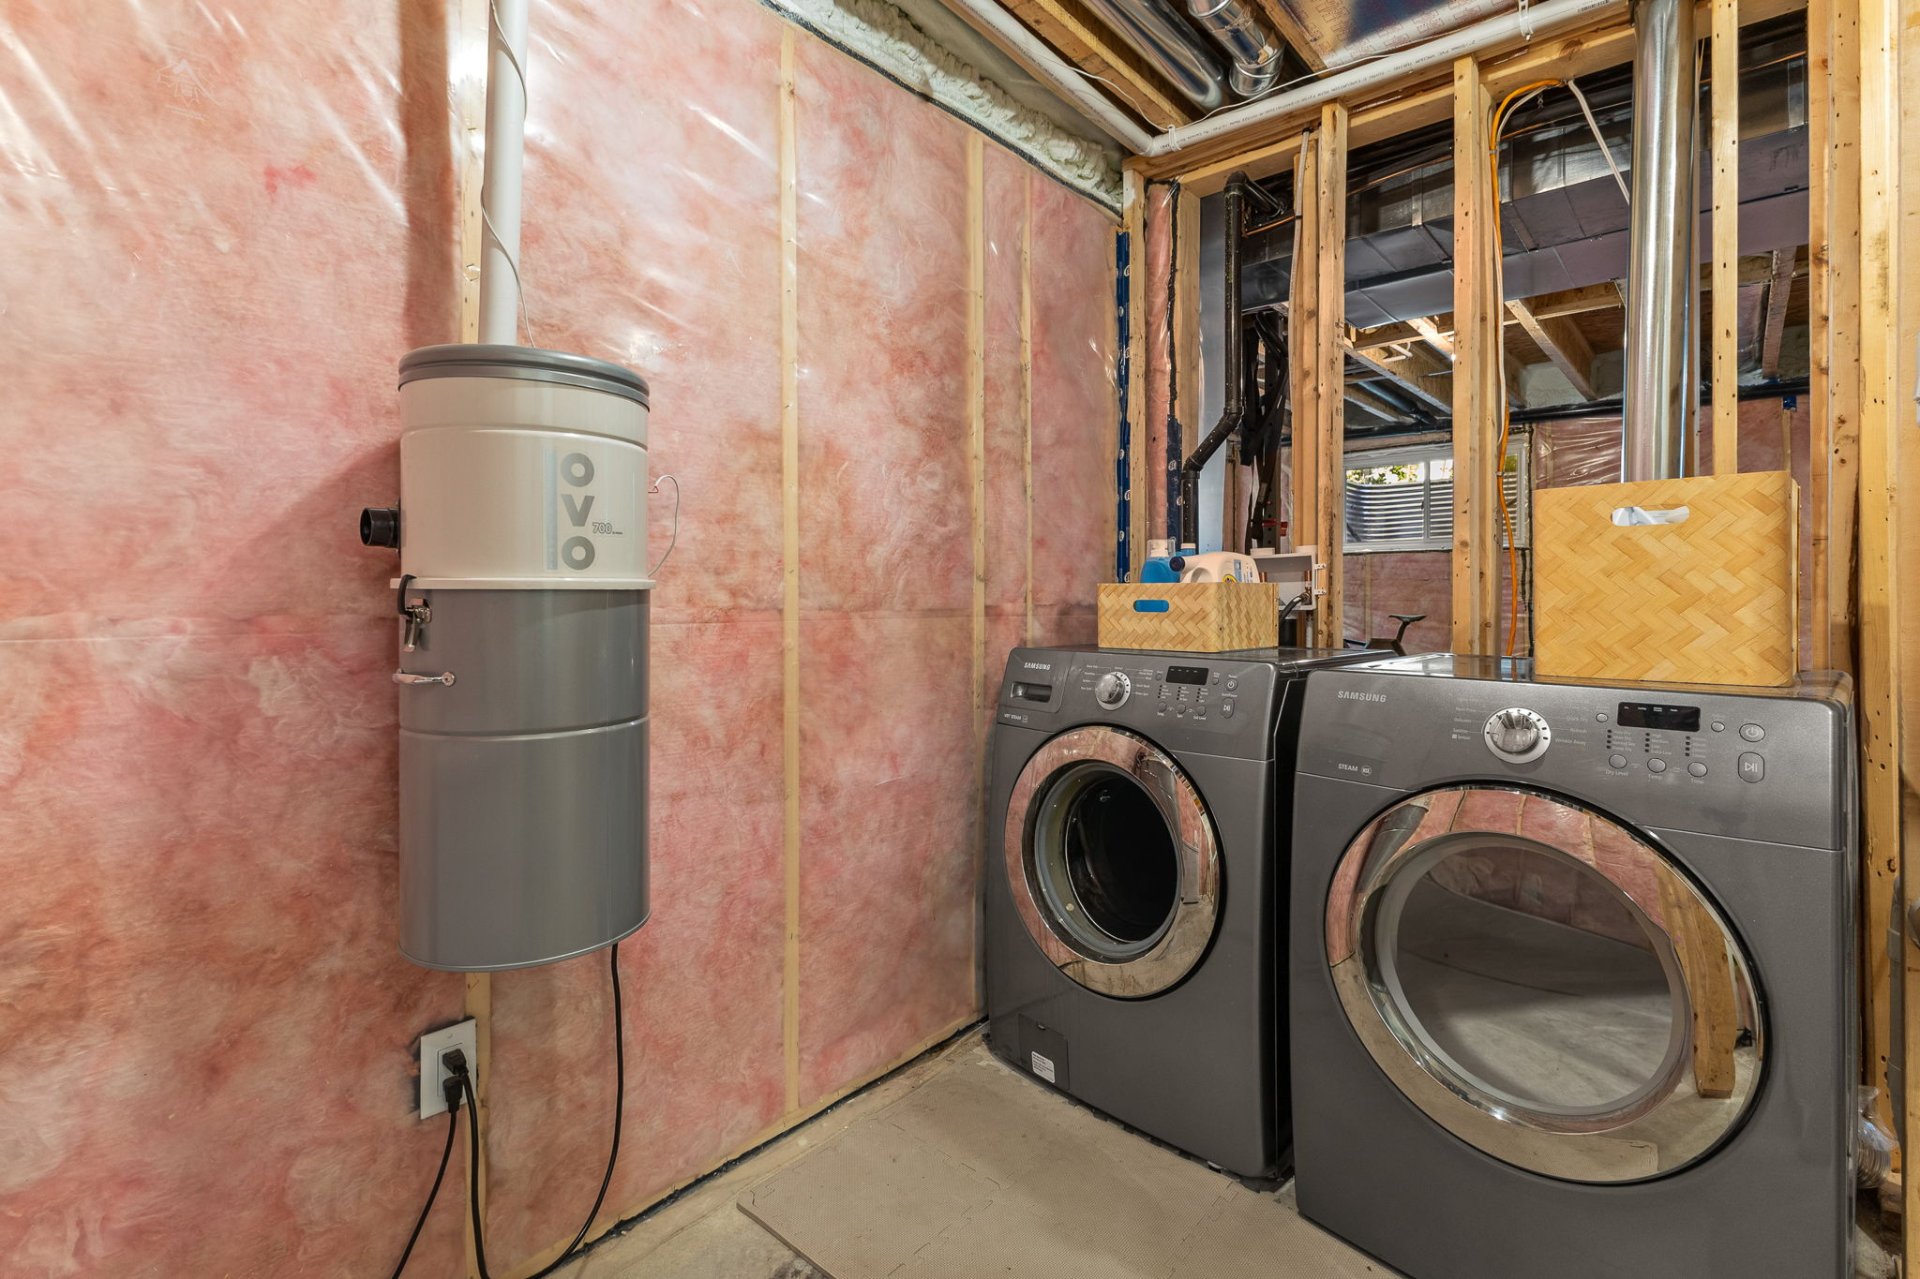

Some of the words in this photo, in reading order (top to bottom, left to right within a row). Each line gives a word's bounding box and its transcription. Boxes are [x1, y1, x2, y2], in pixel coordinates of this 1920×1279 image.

[560, 452, 595, 570] OVO
[592, 521, 612, 534] 700
[1024, 662, 1051, 670] SAMSUNG
[1338, 690, 1387, 703] SAMSUNG
[1338, 763, 1359, 773] STEAM
